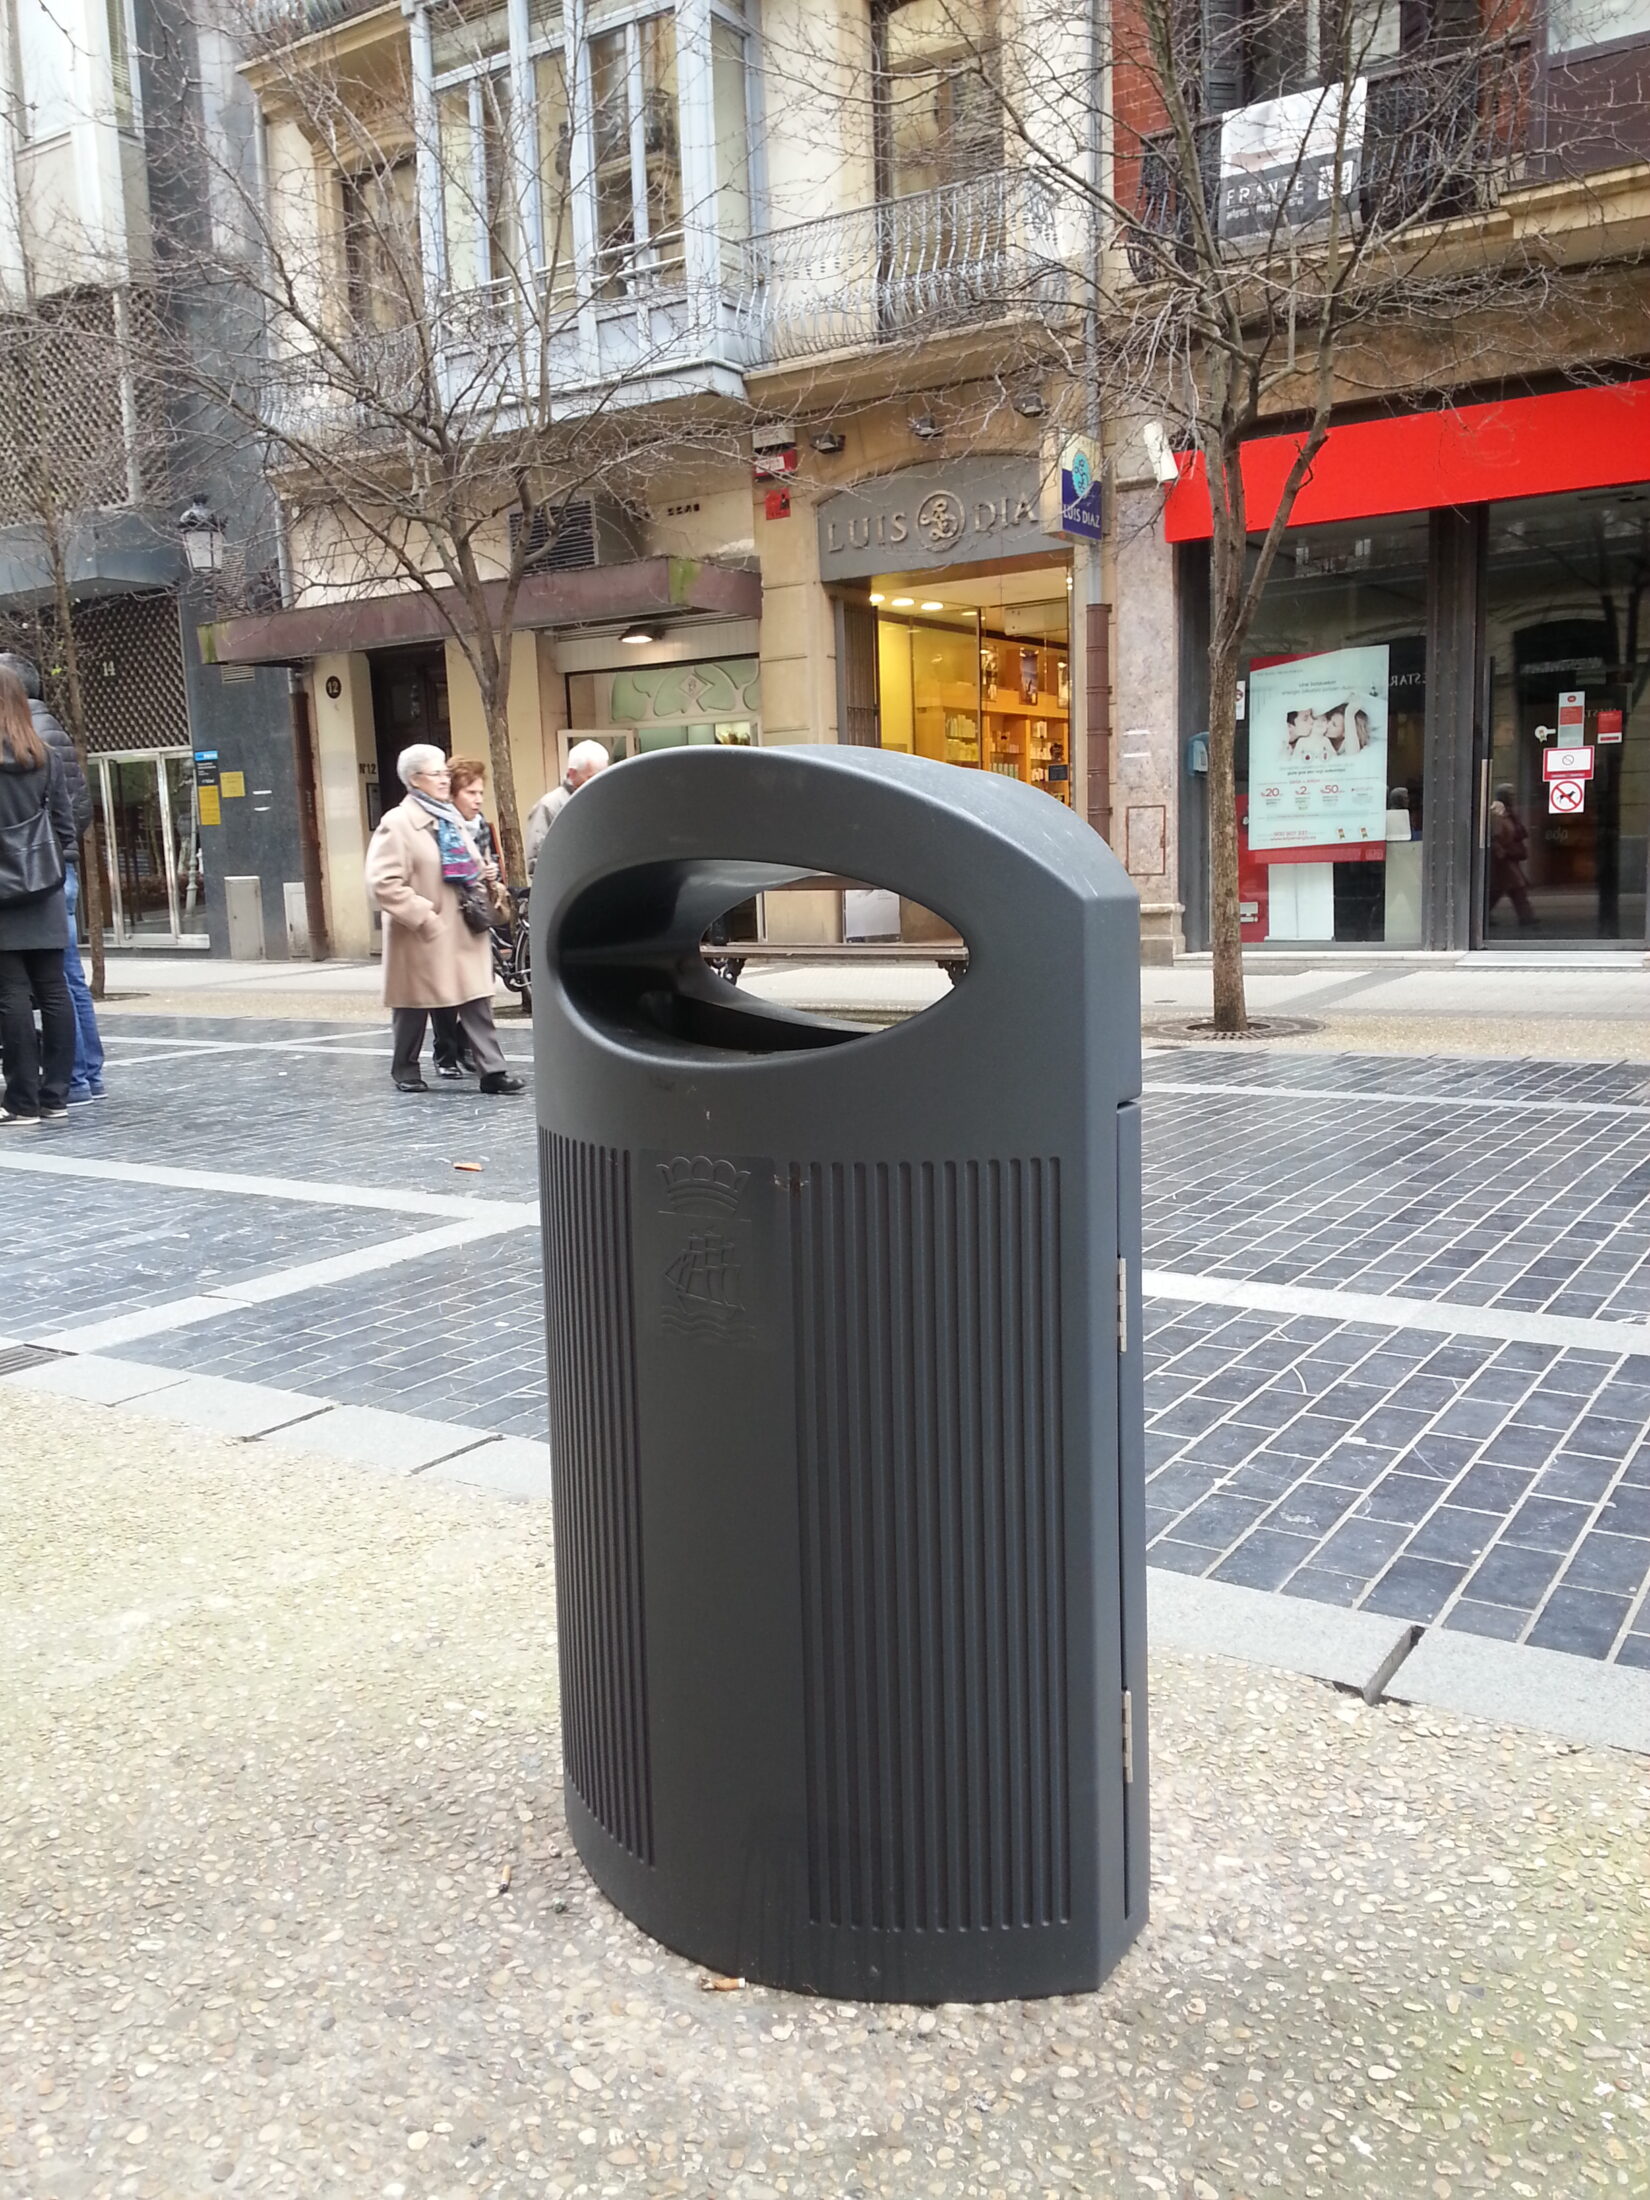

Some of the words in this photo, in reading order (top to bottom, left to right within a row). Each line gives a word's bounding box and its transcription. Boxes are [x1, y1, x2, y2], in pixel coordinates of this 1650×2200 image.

[828, 512, 908, 552] LUIS
[974, 494, 1039, 532] DIA
[1063, 503, 1081, 522] LUIS
[1082, 510, 1100, 528] DIAZ
[102, 660, 116, 676] 14
[328, 681, 339, 694] 12
